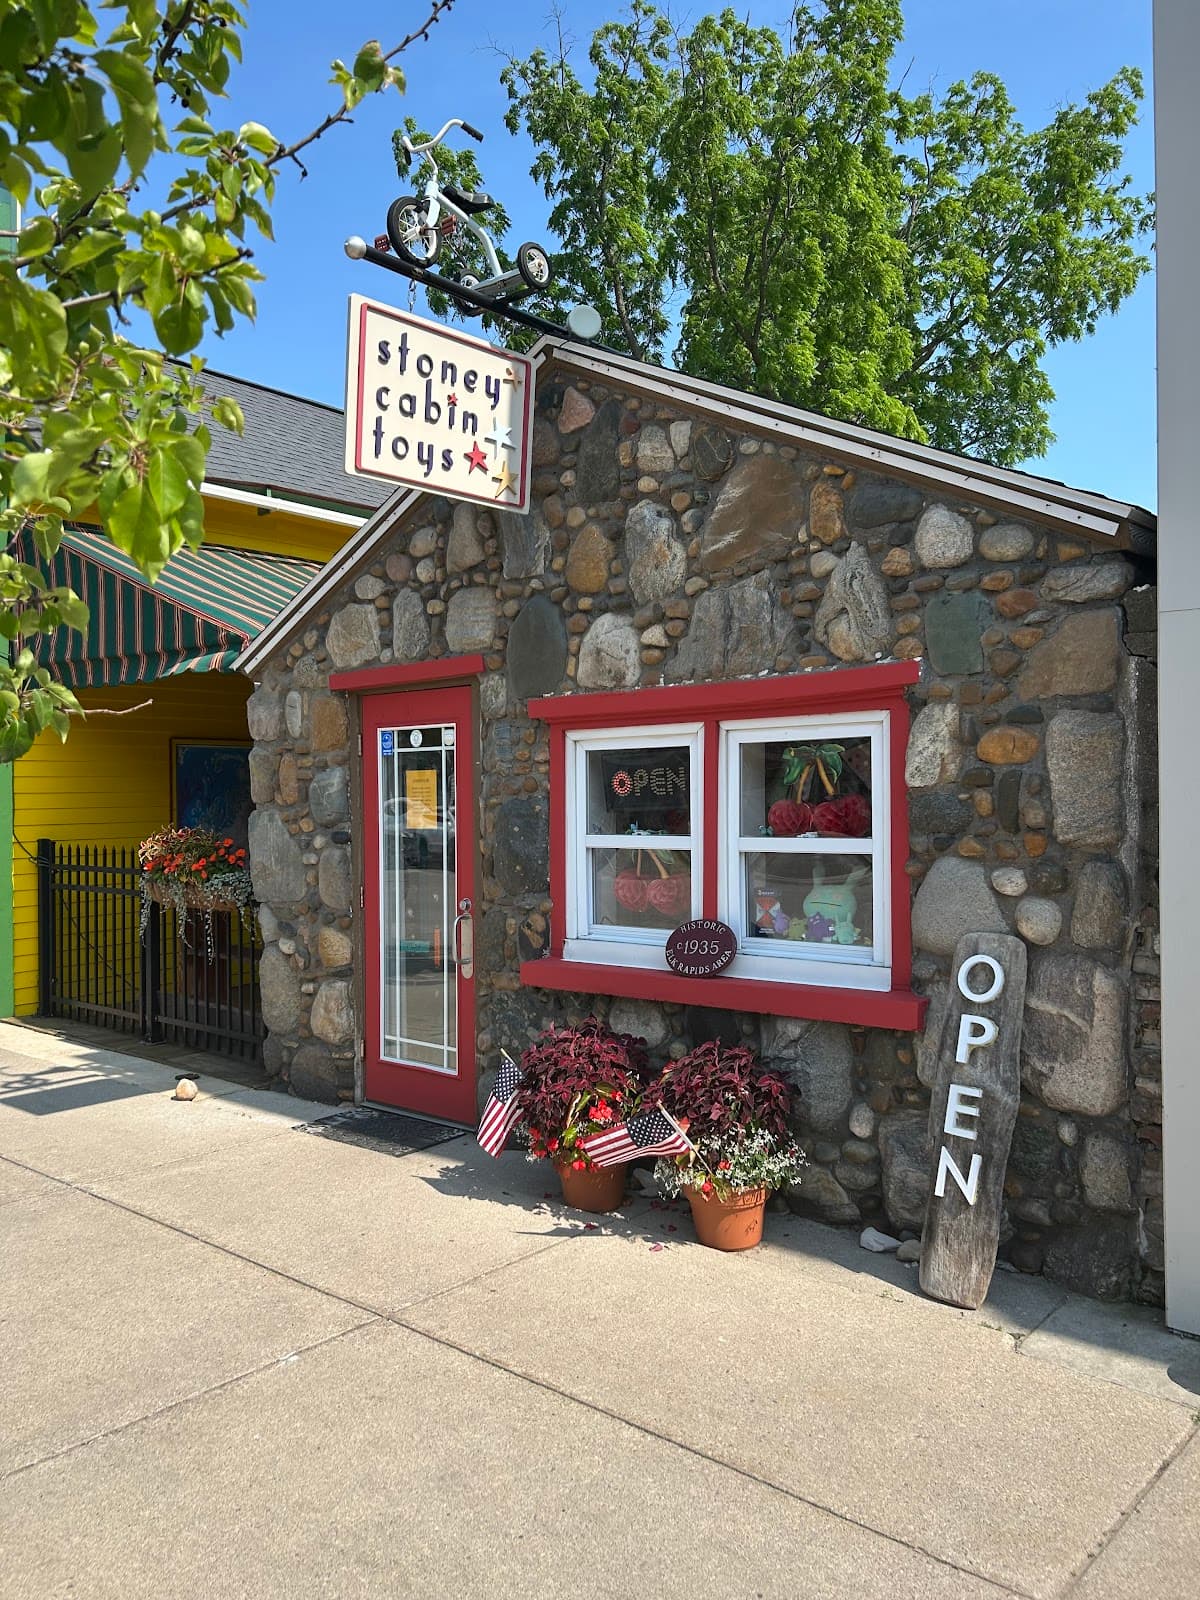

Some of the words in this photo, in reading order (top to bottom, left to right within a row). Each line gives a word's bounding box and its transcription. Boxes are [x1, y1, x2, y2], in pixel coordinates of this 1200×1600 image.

[378, 332, 500, 410] stoney
[375, 378, 478, 436] cabin
[372, 416, 454, 478] toys
[611, 767, 686, 796] OPEN
[680, 921, 726, 934] HISTORIC
[666, 949, 678, 967] ELK
[677, 962, 710, 974] RAPIDS
[712, 950, 732, 970] AREA
[934, 954, 1005, 1206] OPEN
